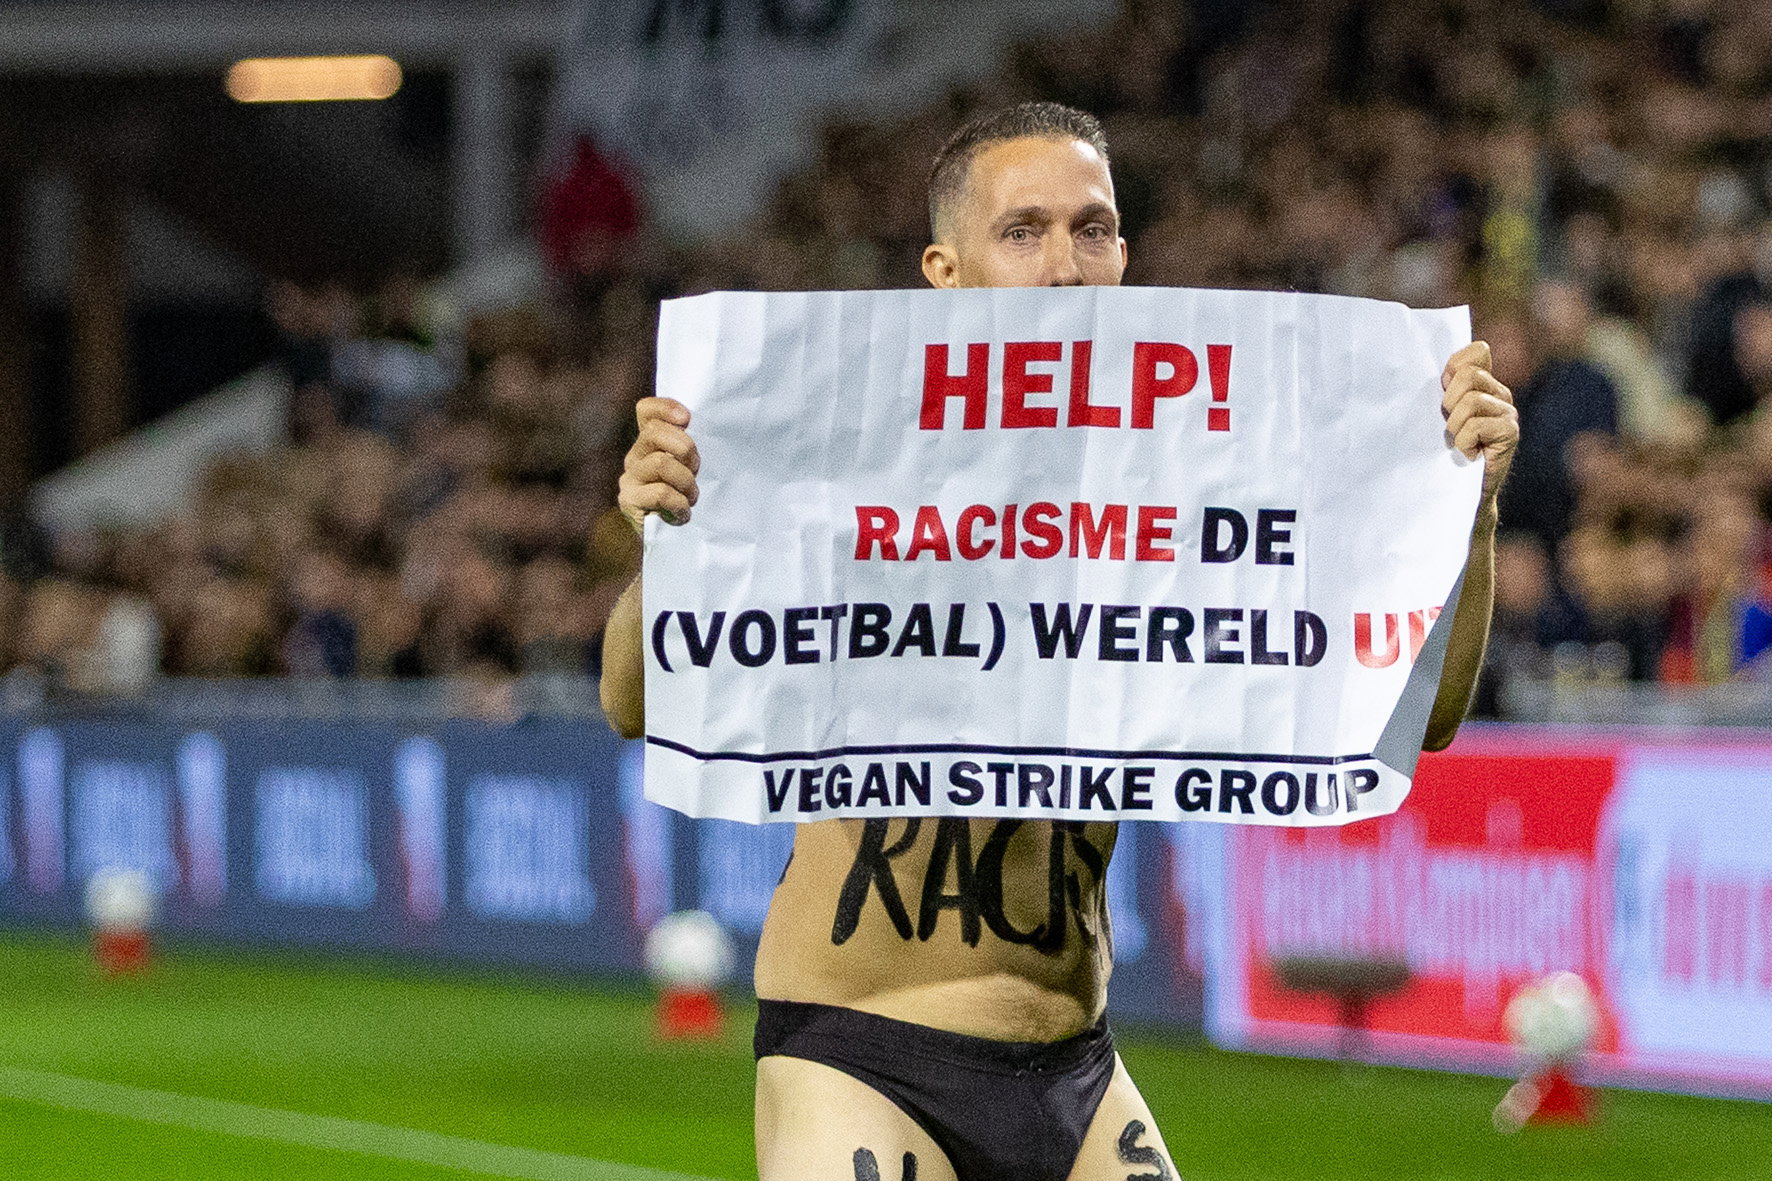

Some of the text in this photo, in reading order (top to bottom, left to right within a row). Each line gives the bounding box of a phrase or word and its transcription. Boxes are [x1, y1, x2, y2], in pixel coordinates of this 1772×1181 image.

[918, 340, 1234, 432] HELP!
[853, 502, 1298, 566] RACISME DE
[651, 601, 1444, 671] (VOETBAL) WERELD UI
[763, 761, 1382, 816] VEGAN STRIKE GROUP
